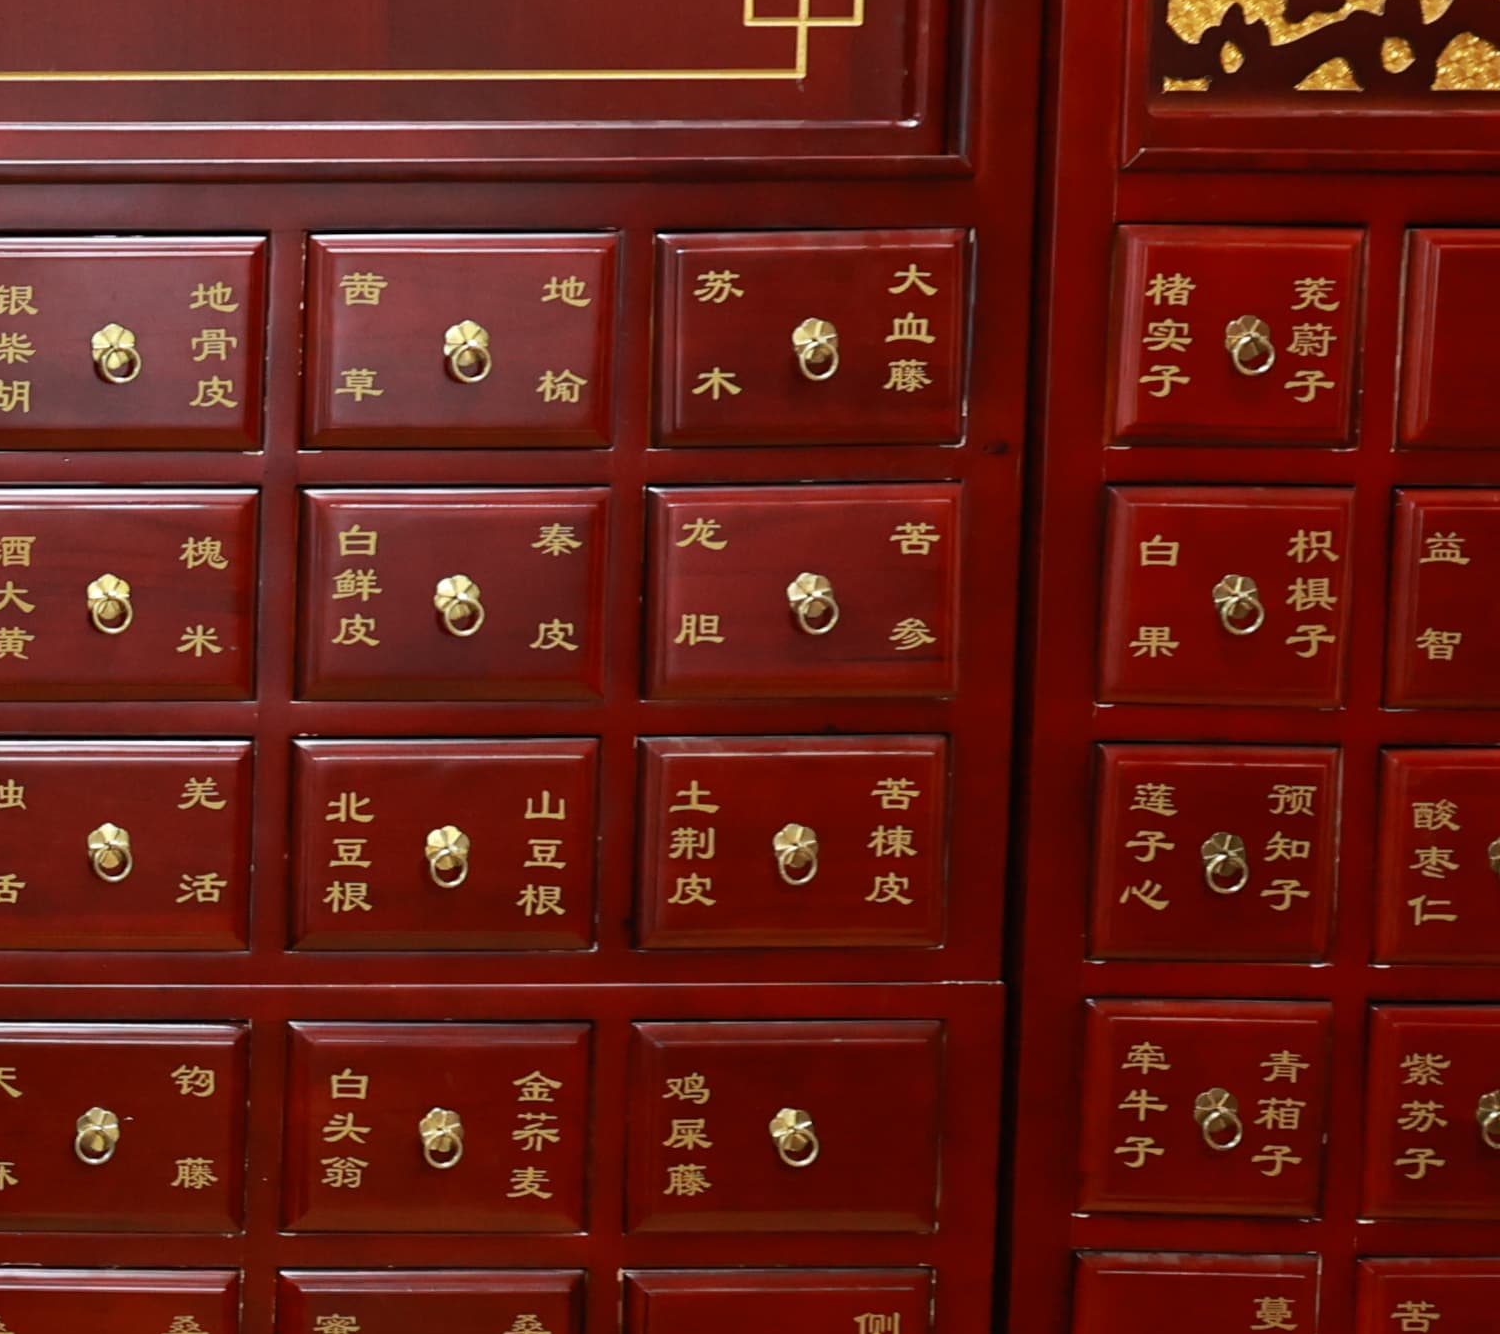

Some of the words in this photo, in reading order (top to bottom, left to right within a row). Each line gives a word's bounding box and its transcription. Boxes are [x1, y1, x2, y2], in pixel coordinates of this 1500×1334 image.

[189, 281, 240, 410] 地骨皮
[690, 269, 746, 401] 苏木
[883, 264, 939, 394] 大血藤
[331, 523, 382, 648] 白鲜皮
[322, 792, 376, 914] 北豆根
[515, 790, 568, 918] 山豆根
[666, 779, 721, 908] 土荆皮
[1119, 782, 1178, 912] 莲子心
[1259, 783, 1319, 912] 预知子
[1406, 798, 1462, 925] 酸枣仁
[319, 1067, 373, 1189] 白头翁
[662, 1072, 714, 1197] 鸡屎藤
[1114, 1041, 1172, 1169] 牵牛子
[1394, 1053, 1452, 1181] 紫苏子
